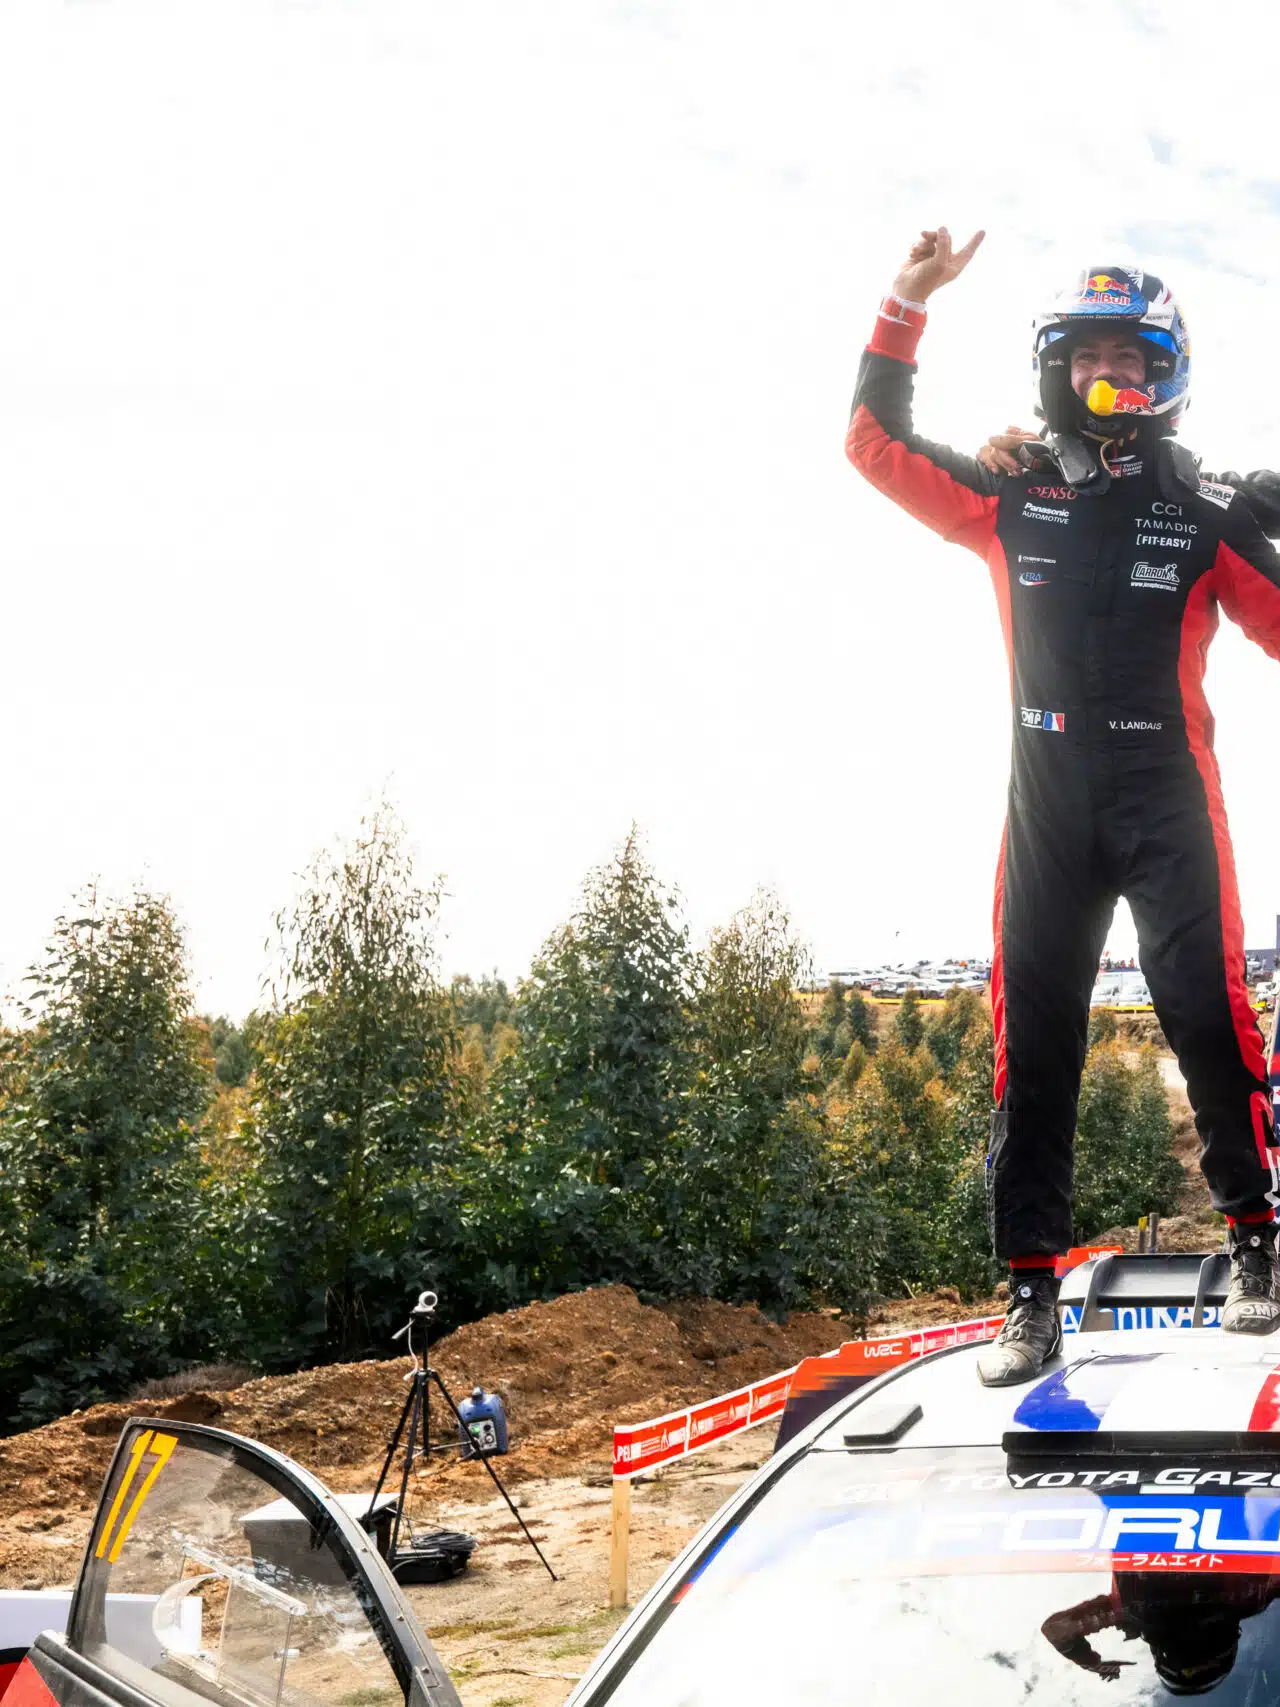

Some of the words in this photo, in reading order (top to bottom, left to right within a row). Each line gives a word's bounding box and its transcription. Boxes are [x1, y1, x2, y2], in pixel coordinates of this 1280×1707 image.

[1101, 293, 1130, 305] Bull
[1200, 485, 1232, 501] OMP
[1022, 510, 1070, 525] AUTOMOTIVE
[1024, 502, 1070, 518] Panasonic
[1134, 518, 1198, 535] TAMADIC
[1109, 720, 1118, 730] V.
[1121, 721, 1162, 730] LANDAIS
[863, 1342, 904, 1358] WRC
[96, 1429, 179, 1564] 17
